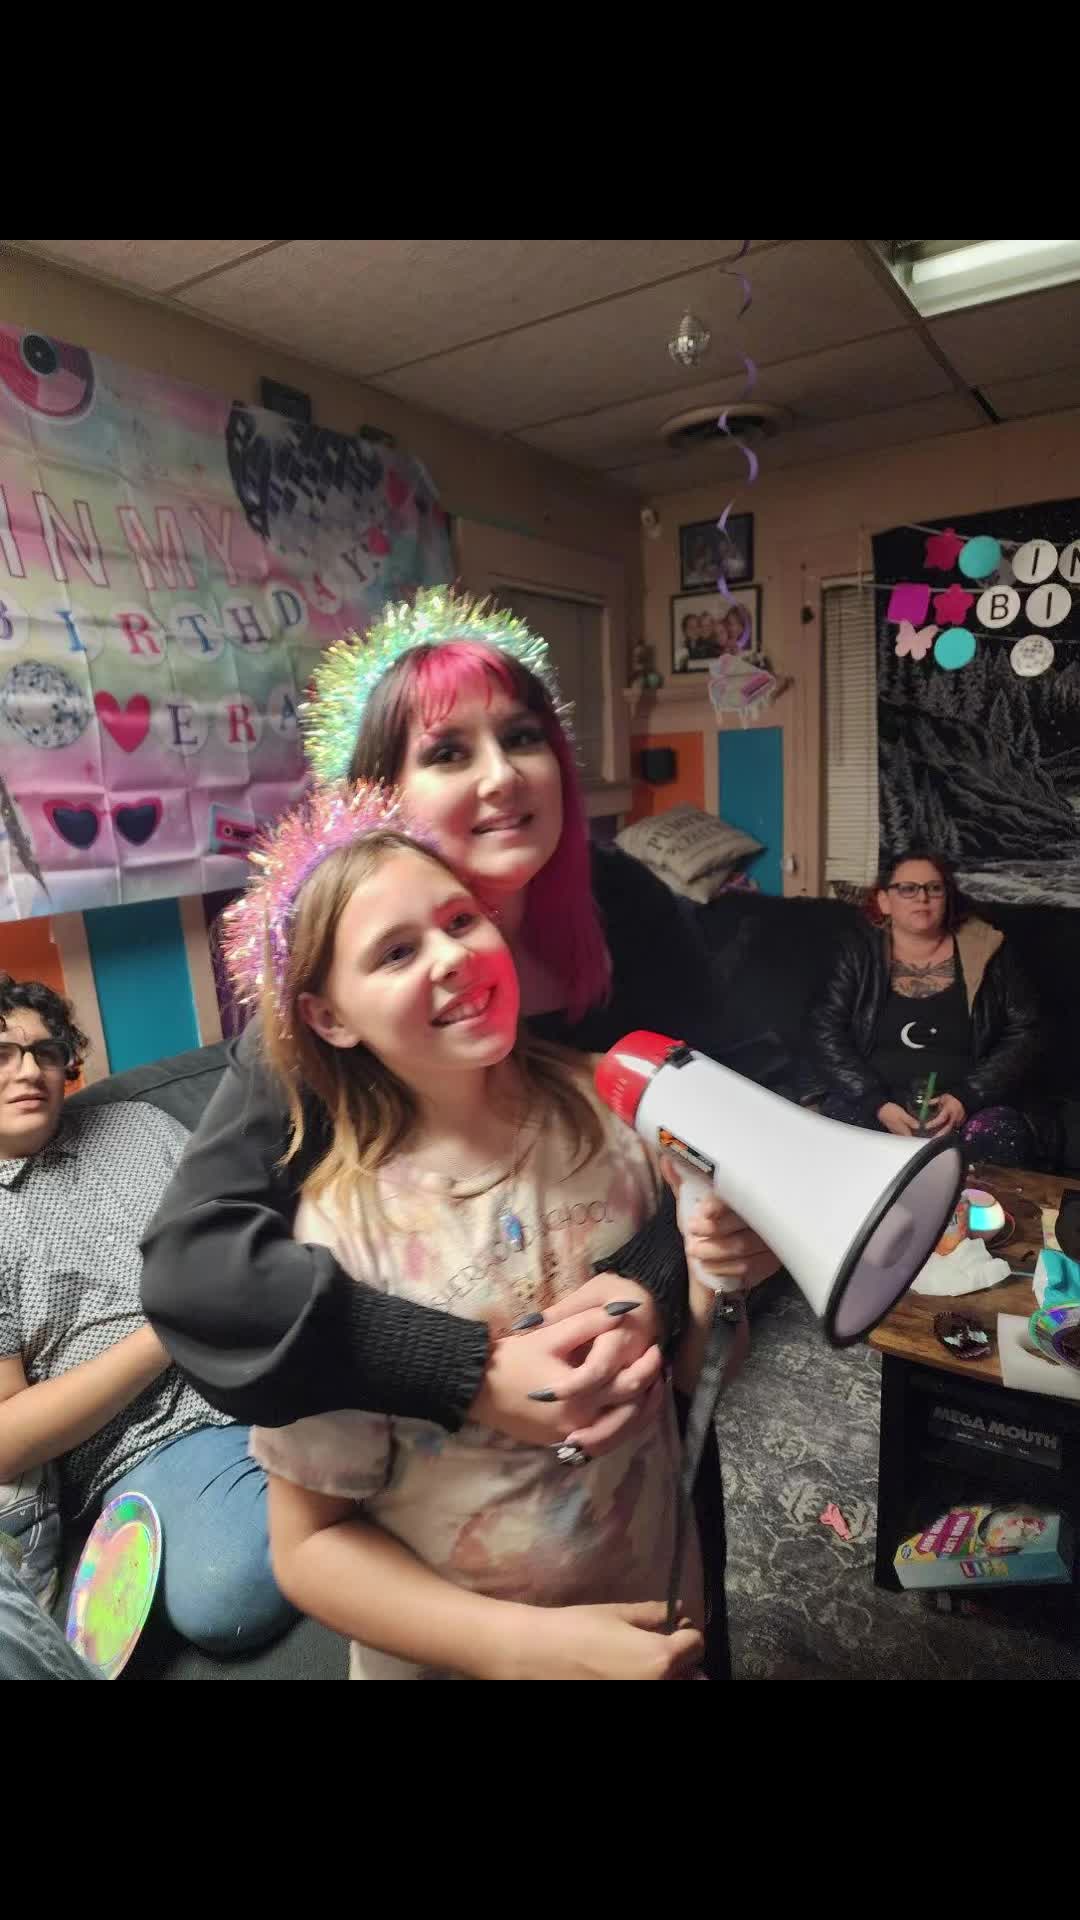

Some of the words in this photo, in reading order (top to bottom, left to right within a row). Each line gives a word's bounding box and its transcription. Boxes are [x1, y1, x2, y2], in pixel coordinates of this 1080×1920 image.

[0, 484, 109, 587] IN
[117, 505, 238, 590] MY
[990, 592, 1053, 621] BI
[167, 694, 298, 745] ERA
[933, 1406, 985, 1431] MEGA
[988, 1421, 1056, 1449] MOUTH
